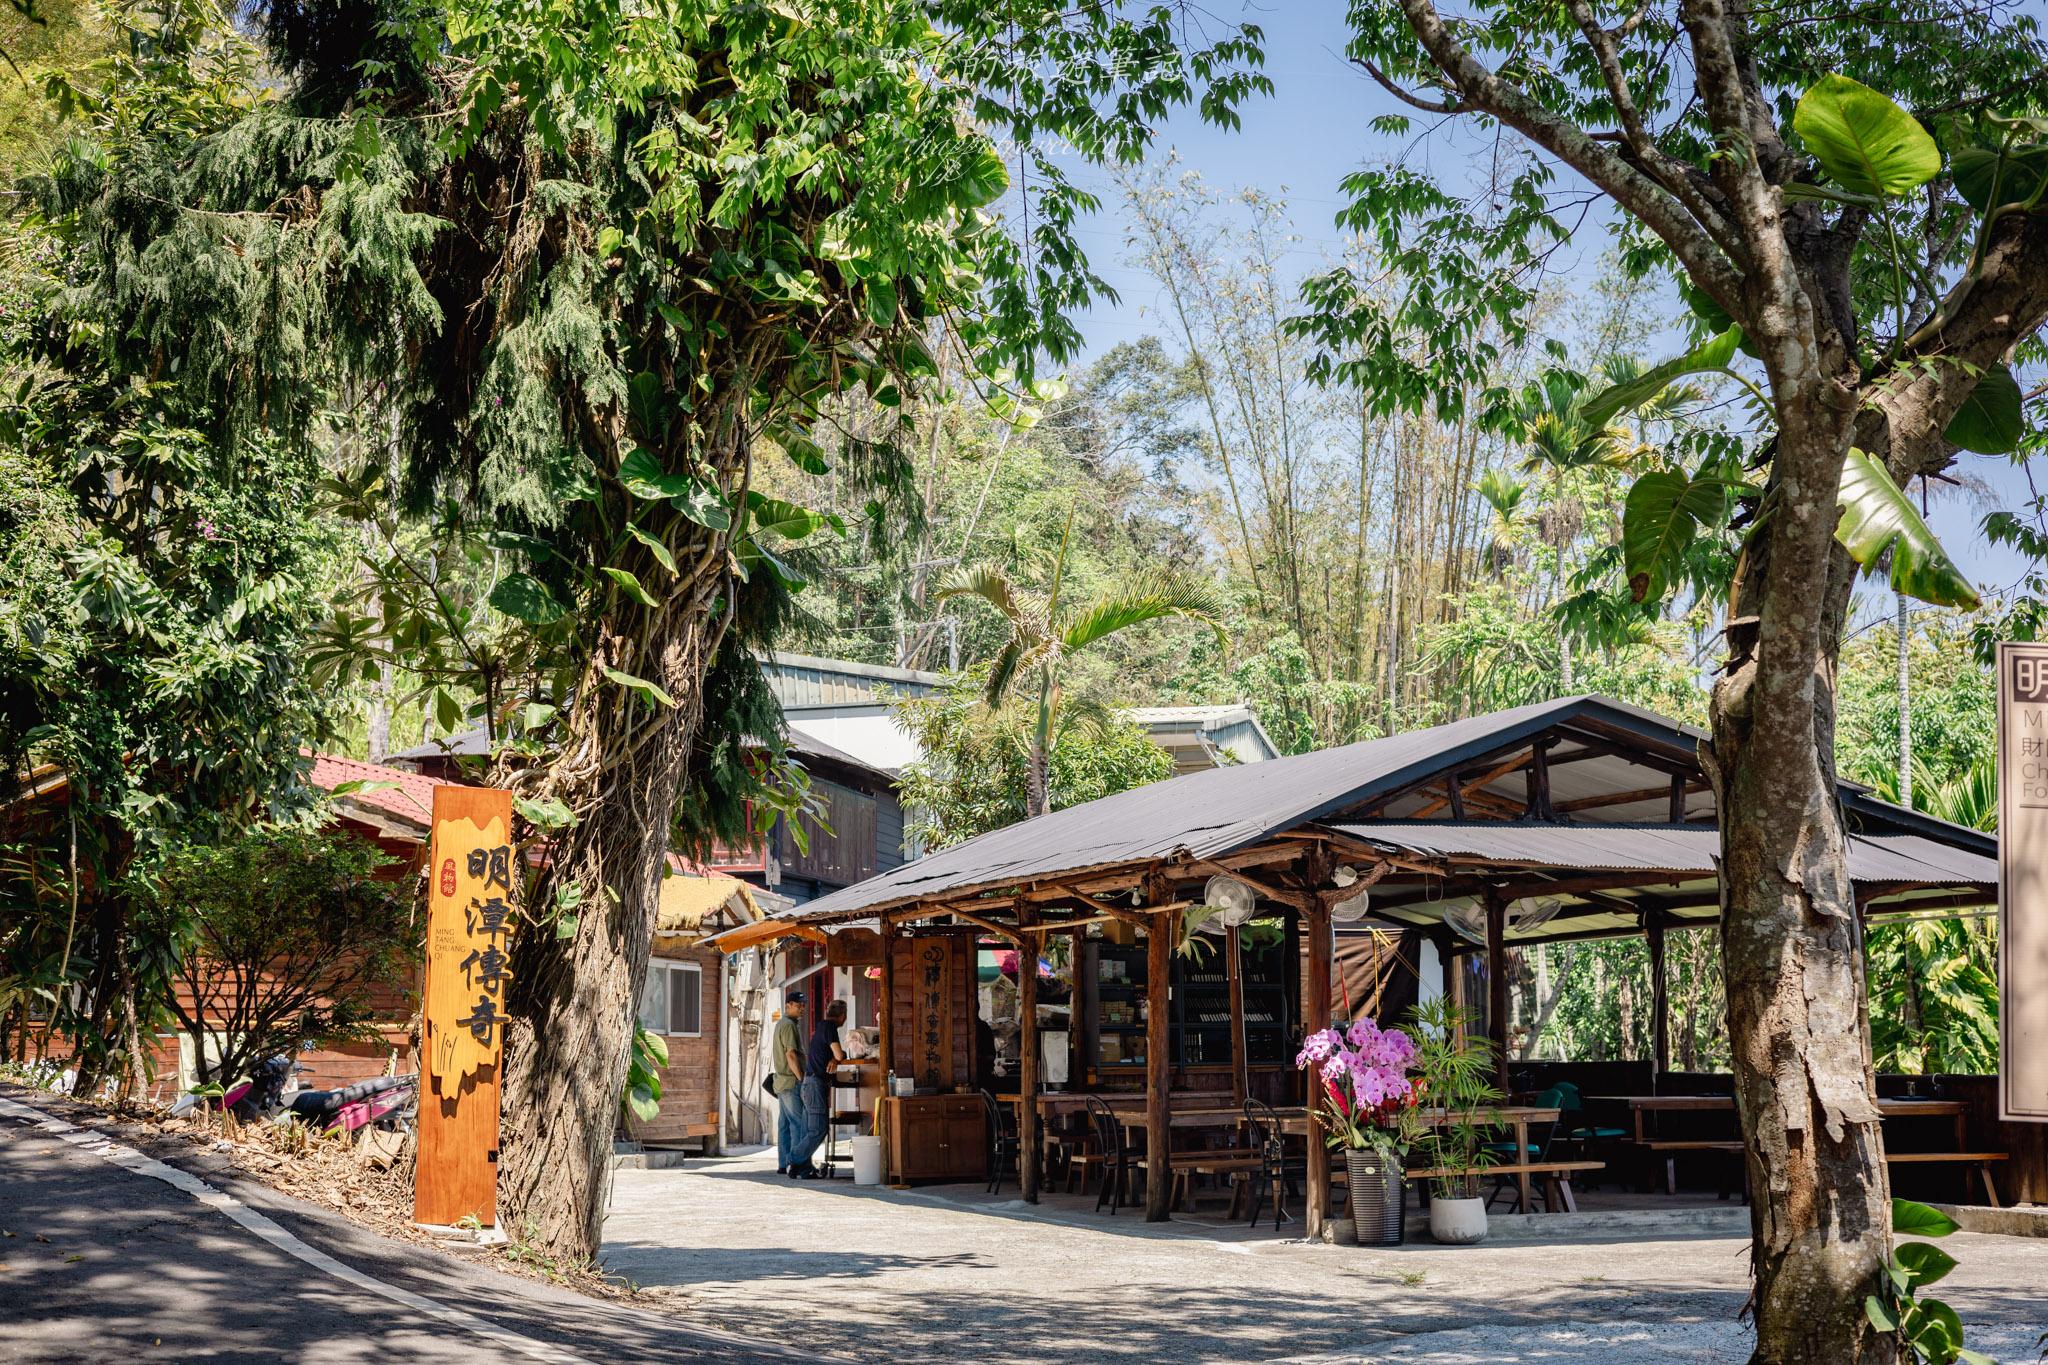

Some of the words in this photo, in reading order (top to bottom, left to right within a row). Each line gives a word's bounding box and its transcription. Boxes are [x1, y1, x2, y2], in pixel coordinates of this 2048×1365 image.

[2022, 737, 2048, 758] 財
[435, 928, 455, 936] MING
[435, 936, 455, 944] TANG
[434, 944, 465, 953] CHUANG
[456, 845, 511, 1049] 明潭傳奇
[434, 952, 443, 960] QI
